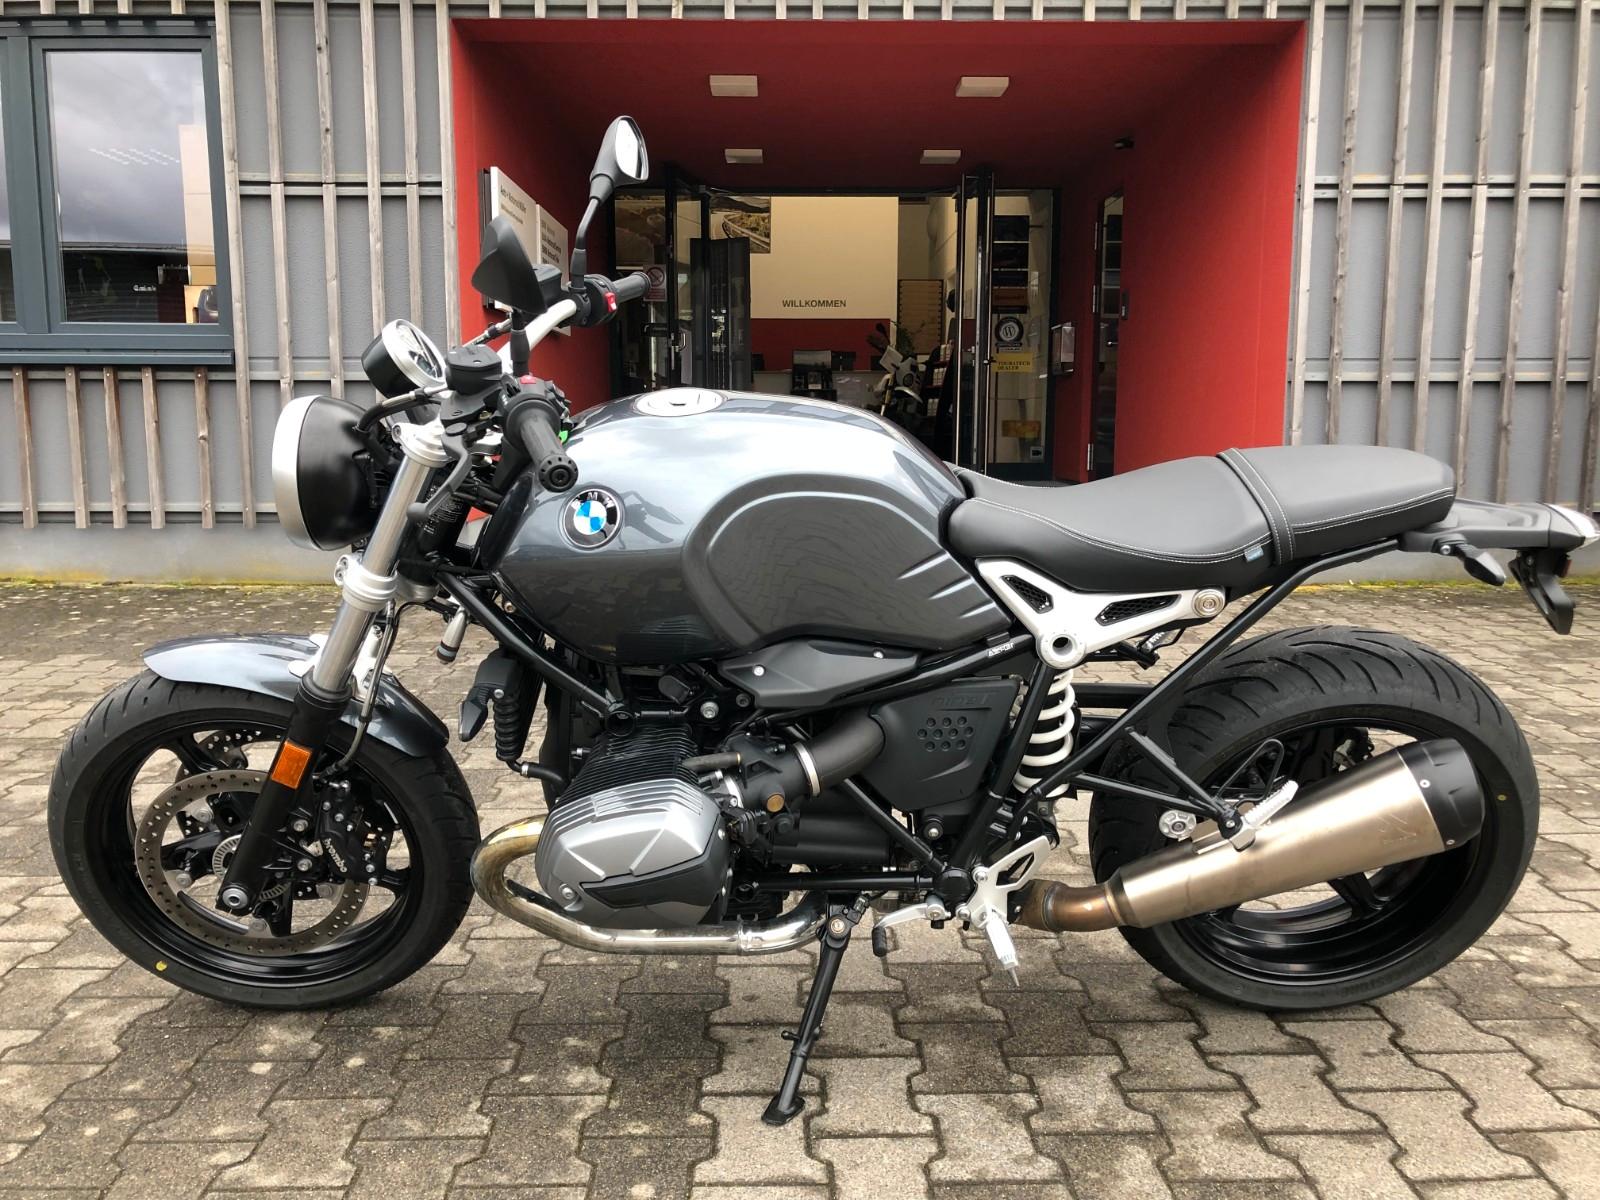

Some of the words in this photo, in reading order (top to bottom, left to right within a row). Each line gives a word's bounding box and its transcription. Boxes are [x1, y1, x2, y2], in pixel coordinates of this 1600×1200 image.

[782, 299, 847, 308] WILLKOMMEN
[570, 491, 616, 510] BMW
[323, 838, 347, 873] brembo
